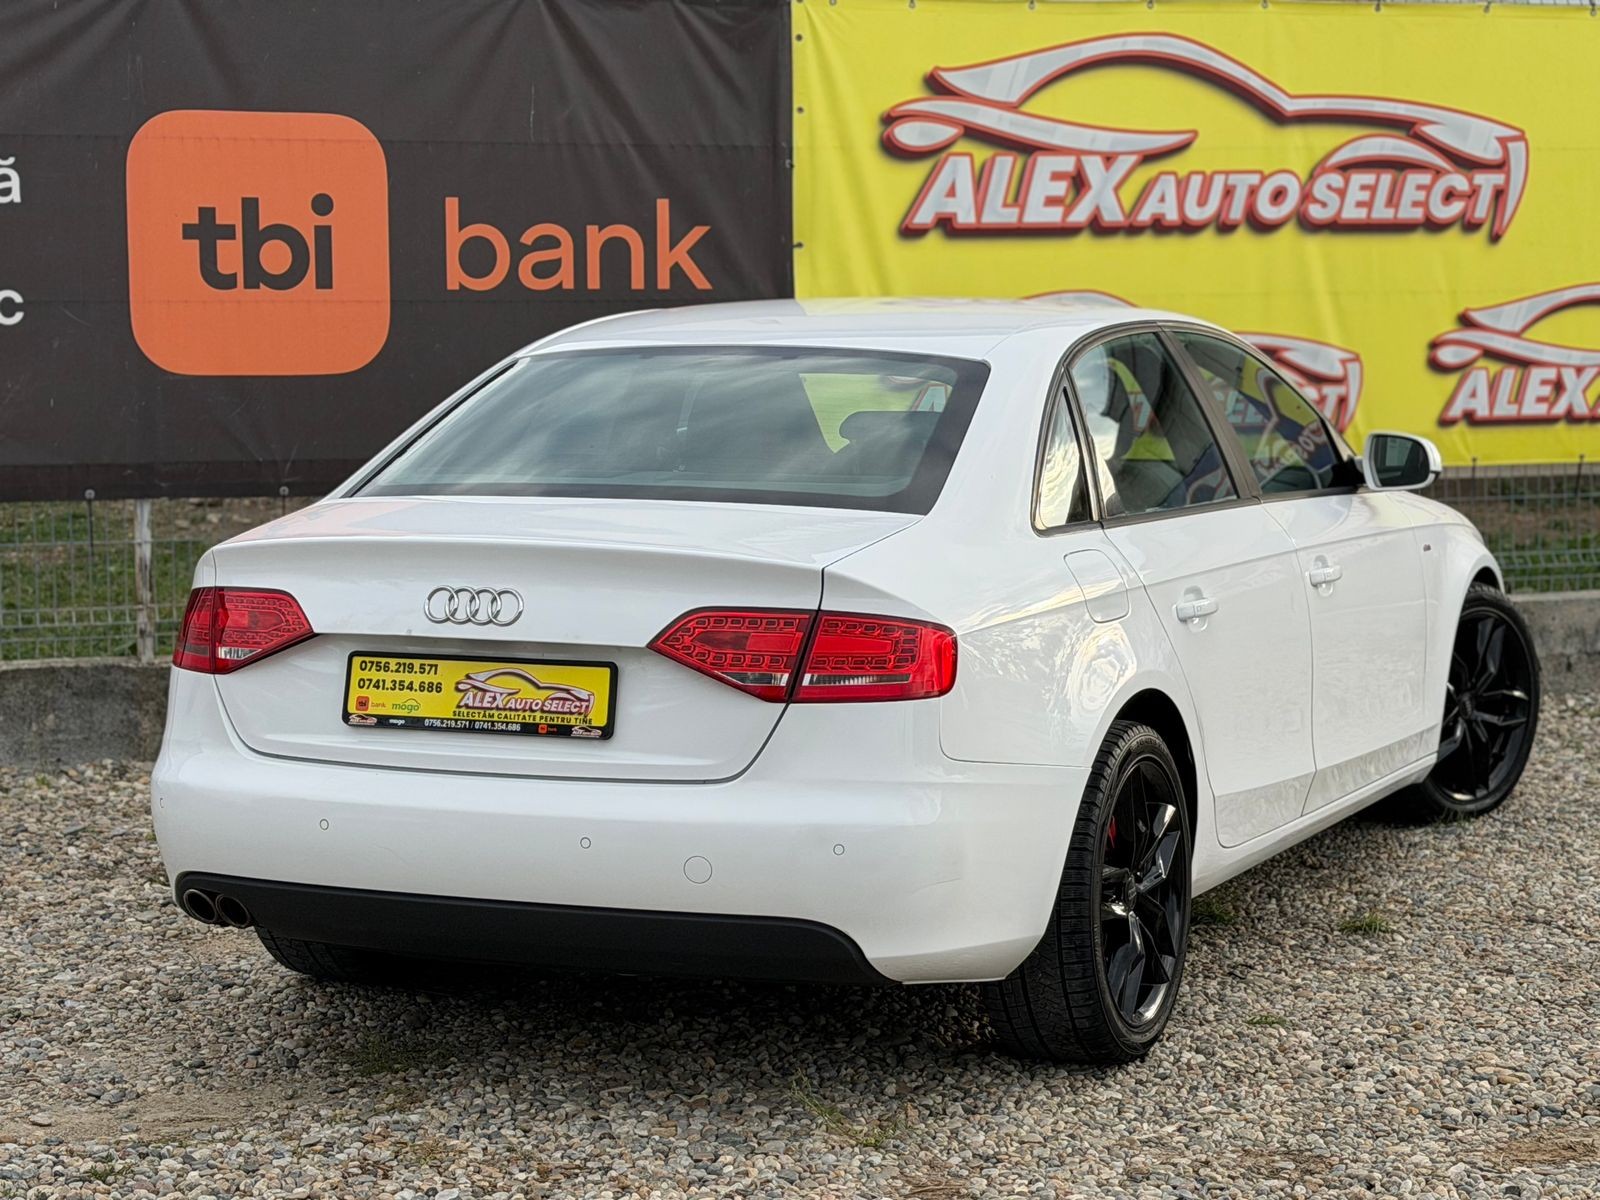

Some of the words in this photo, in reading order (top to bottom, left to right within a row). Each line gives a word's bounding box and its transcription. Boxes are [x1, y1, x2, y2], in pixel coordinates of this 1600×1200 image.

[903, 152, 1140, 230] ALEX
[1133, 170, 1302, 227] AUTO
[1305, 170, 1507, 226] SELECT
[182, 194, 334, 290] tbi
[445, 197, 713, 291] bank
[1441, 366, 1598, 422] ALEX
[359, 660, 439, 675] 0756.219.571
[357, 678, 443, 693] 0741.354.686
[391, 703, 420, 713] mogo
[457, 691, 508, 709] ALEX
[506, 698, 542, 711] AUTO
[543, 700, 590, 714] SELECT
[424, 719, 469, 728] 0756.219.571
[475, 721, 521, 731] 0741.354.686
[497, 713, 537, 722] CALITATE
[539, 715, 572, 724] PENTRU
[574, 717, 593, 725] TINE
